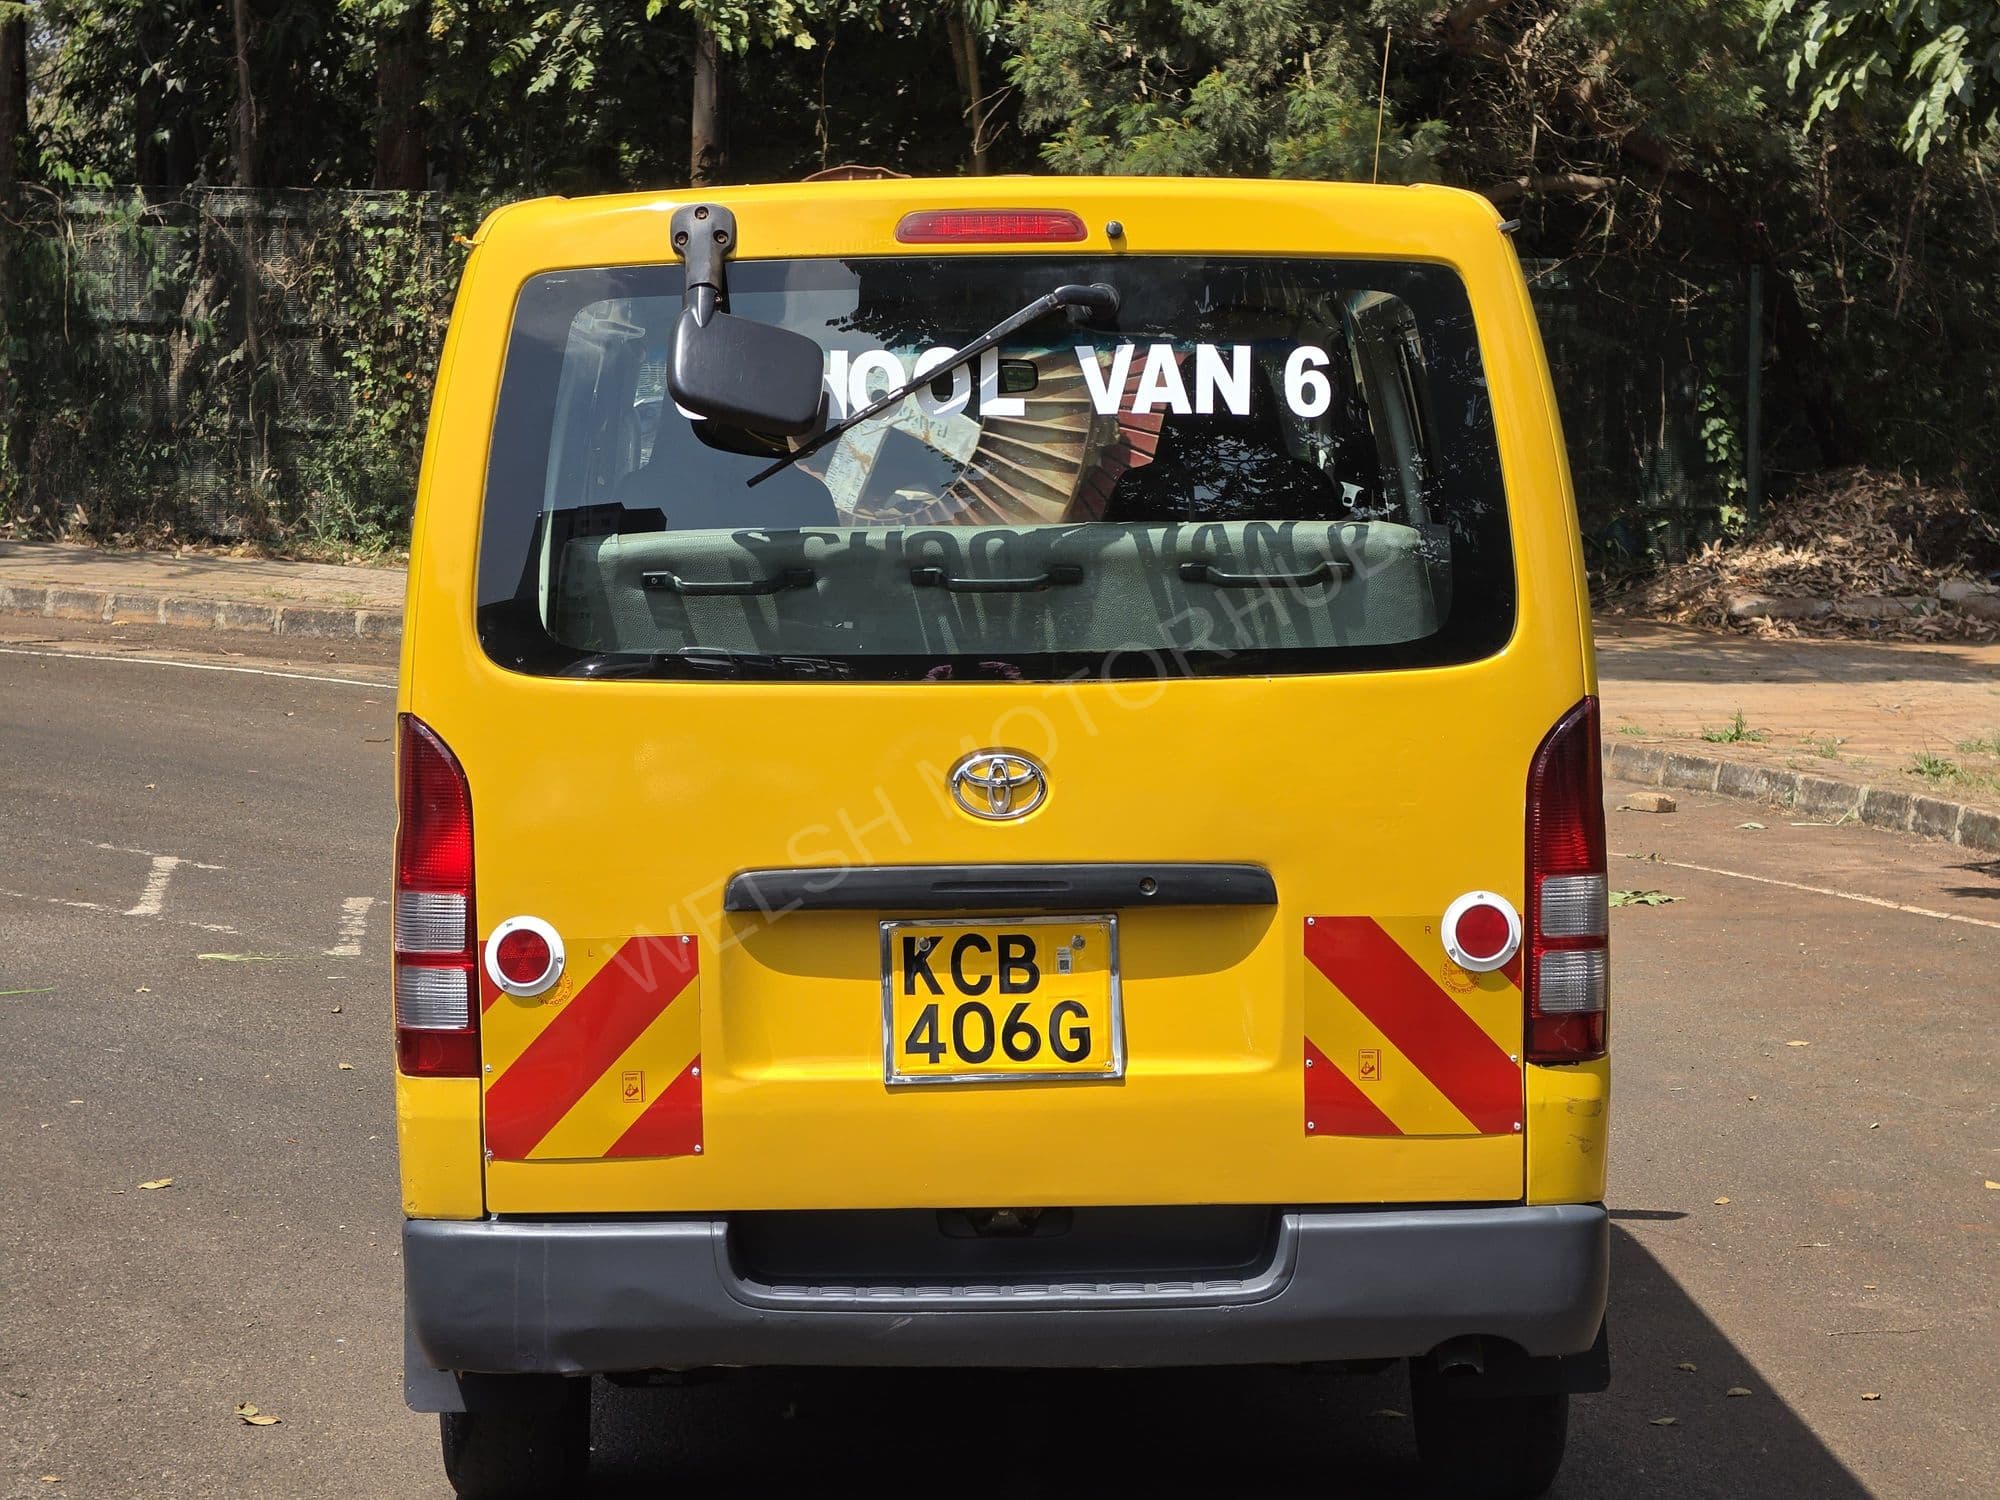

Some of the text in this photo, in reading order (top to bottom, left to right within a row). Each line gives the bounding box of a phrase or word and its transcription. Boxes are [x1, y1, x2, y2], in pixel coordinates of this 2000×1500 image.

[1074, 343, 1251, 415] VAN
[1284, 345, 1332, 418] 6
[1424, 925, 1432, 935] R
[902, 933, 1041, 996] KCB
[905, 1000, 1092, 1064] 406G
